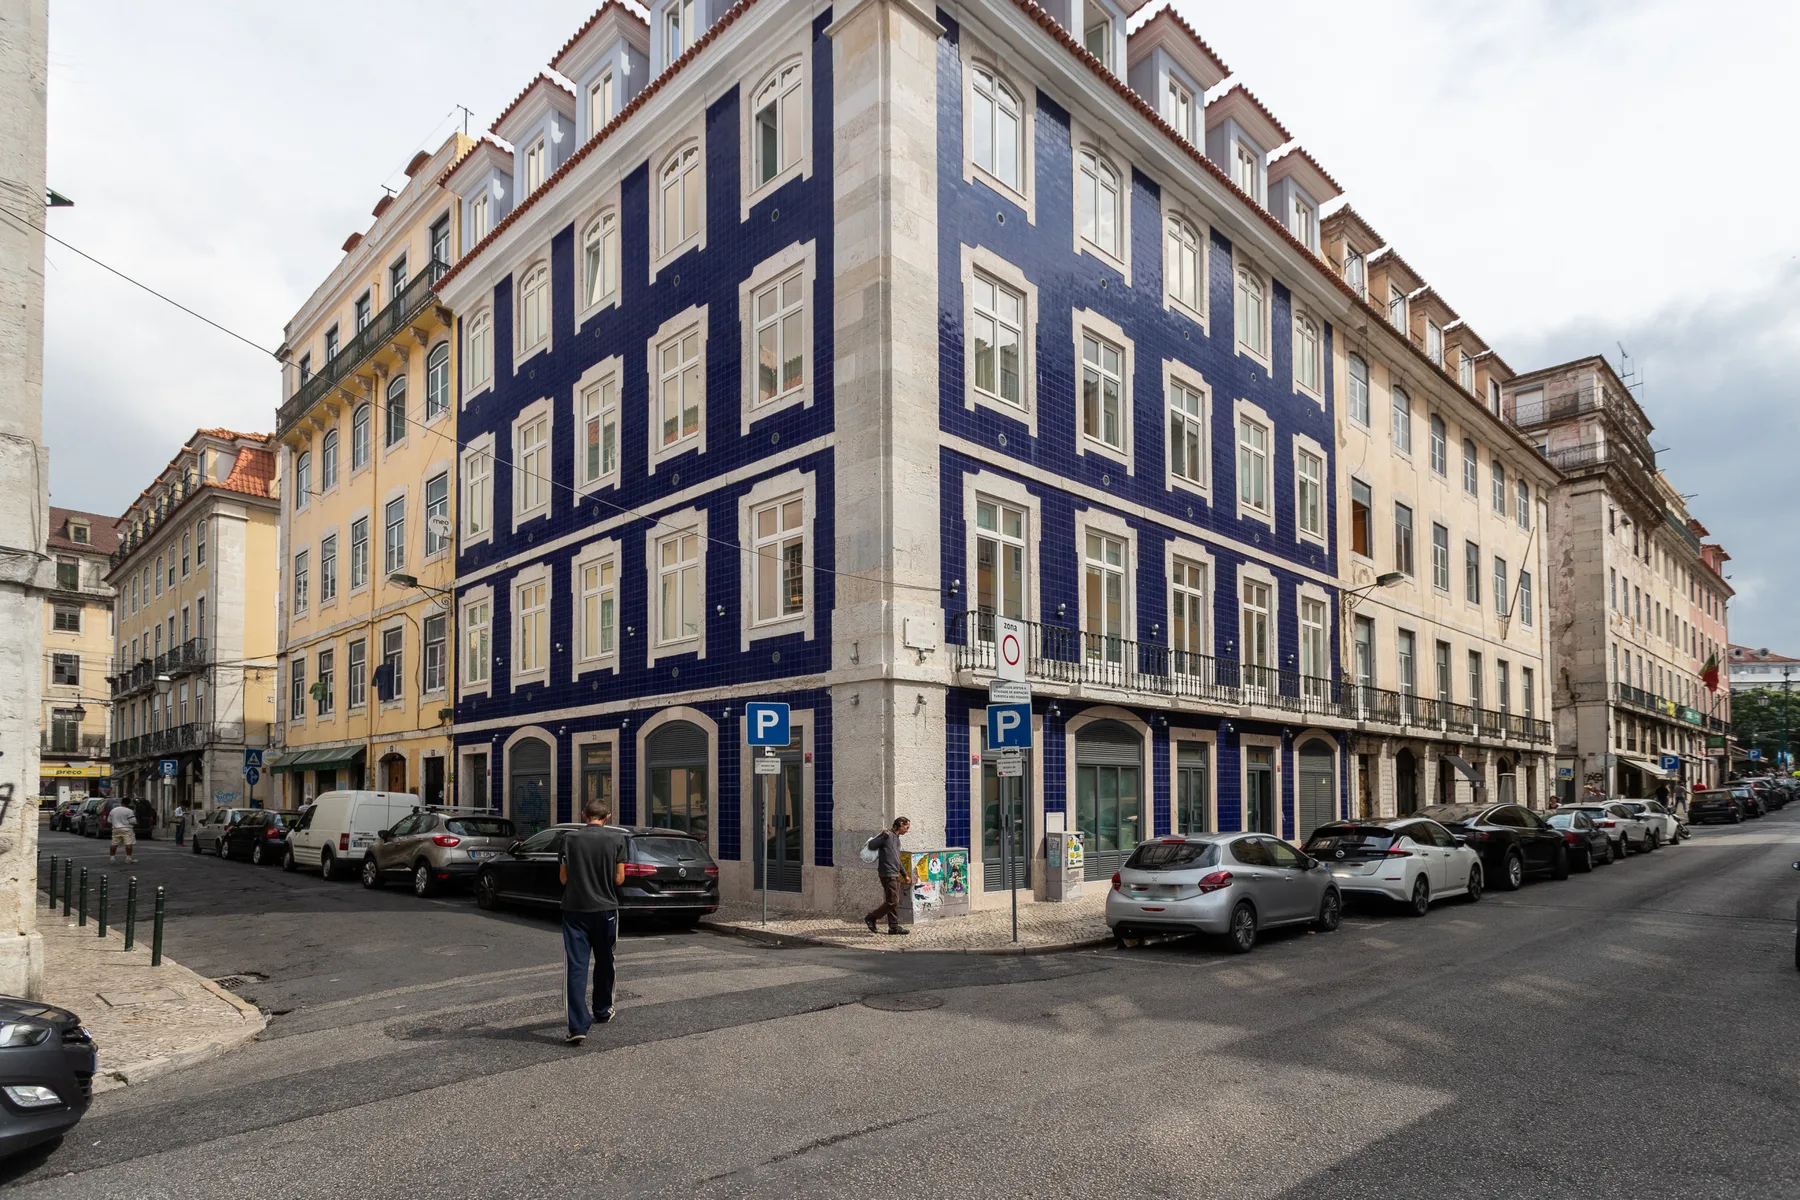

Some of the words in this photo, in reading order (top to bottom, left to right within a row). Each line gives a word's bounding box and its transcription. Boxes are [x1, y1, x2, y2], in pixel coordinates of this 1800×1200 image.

[1003, 622, 1018, 632] zona
[757, 710, 779, 739] P
[996, 710, 1021, 743] P
[1751, 750, 1759, 759] P
[1664, 757, 1675, 768] P
